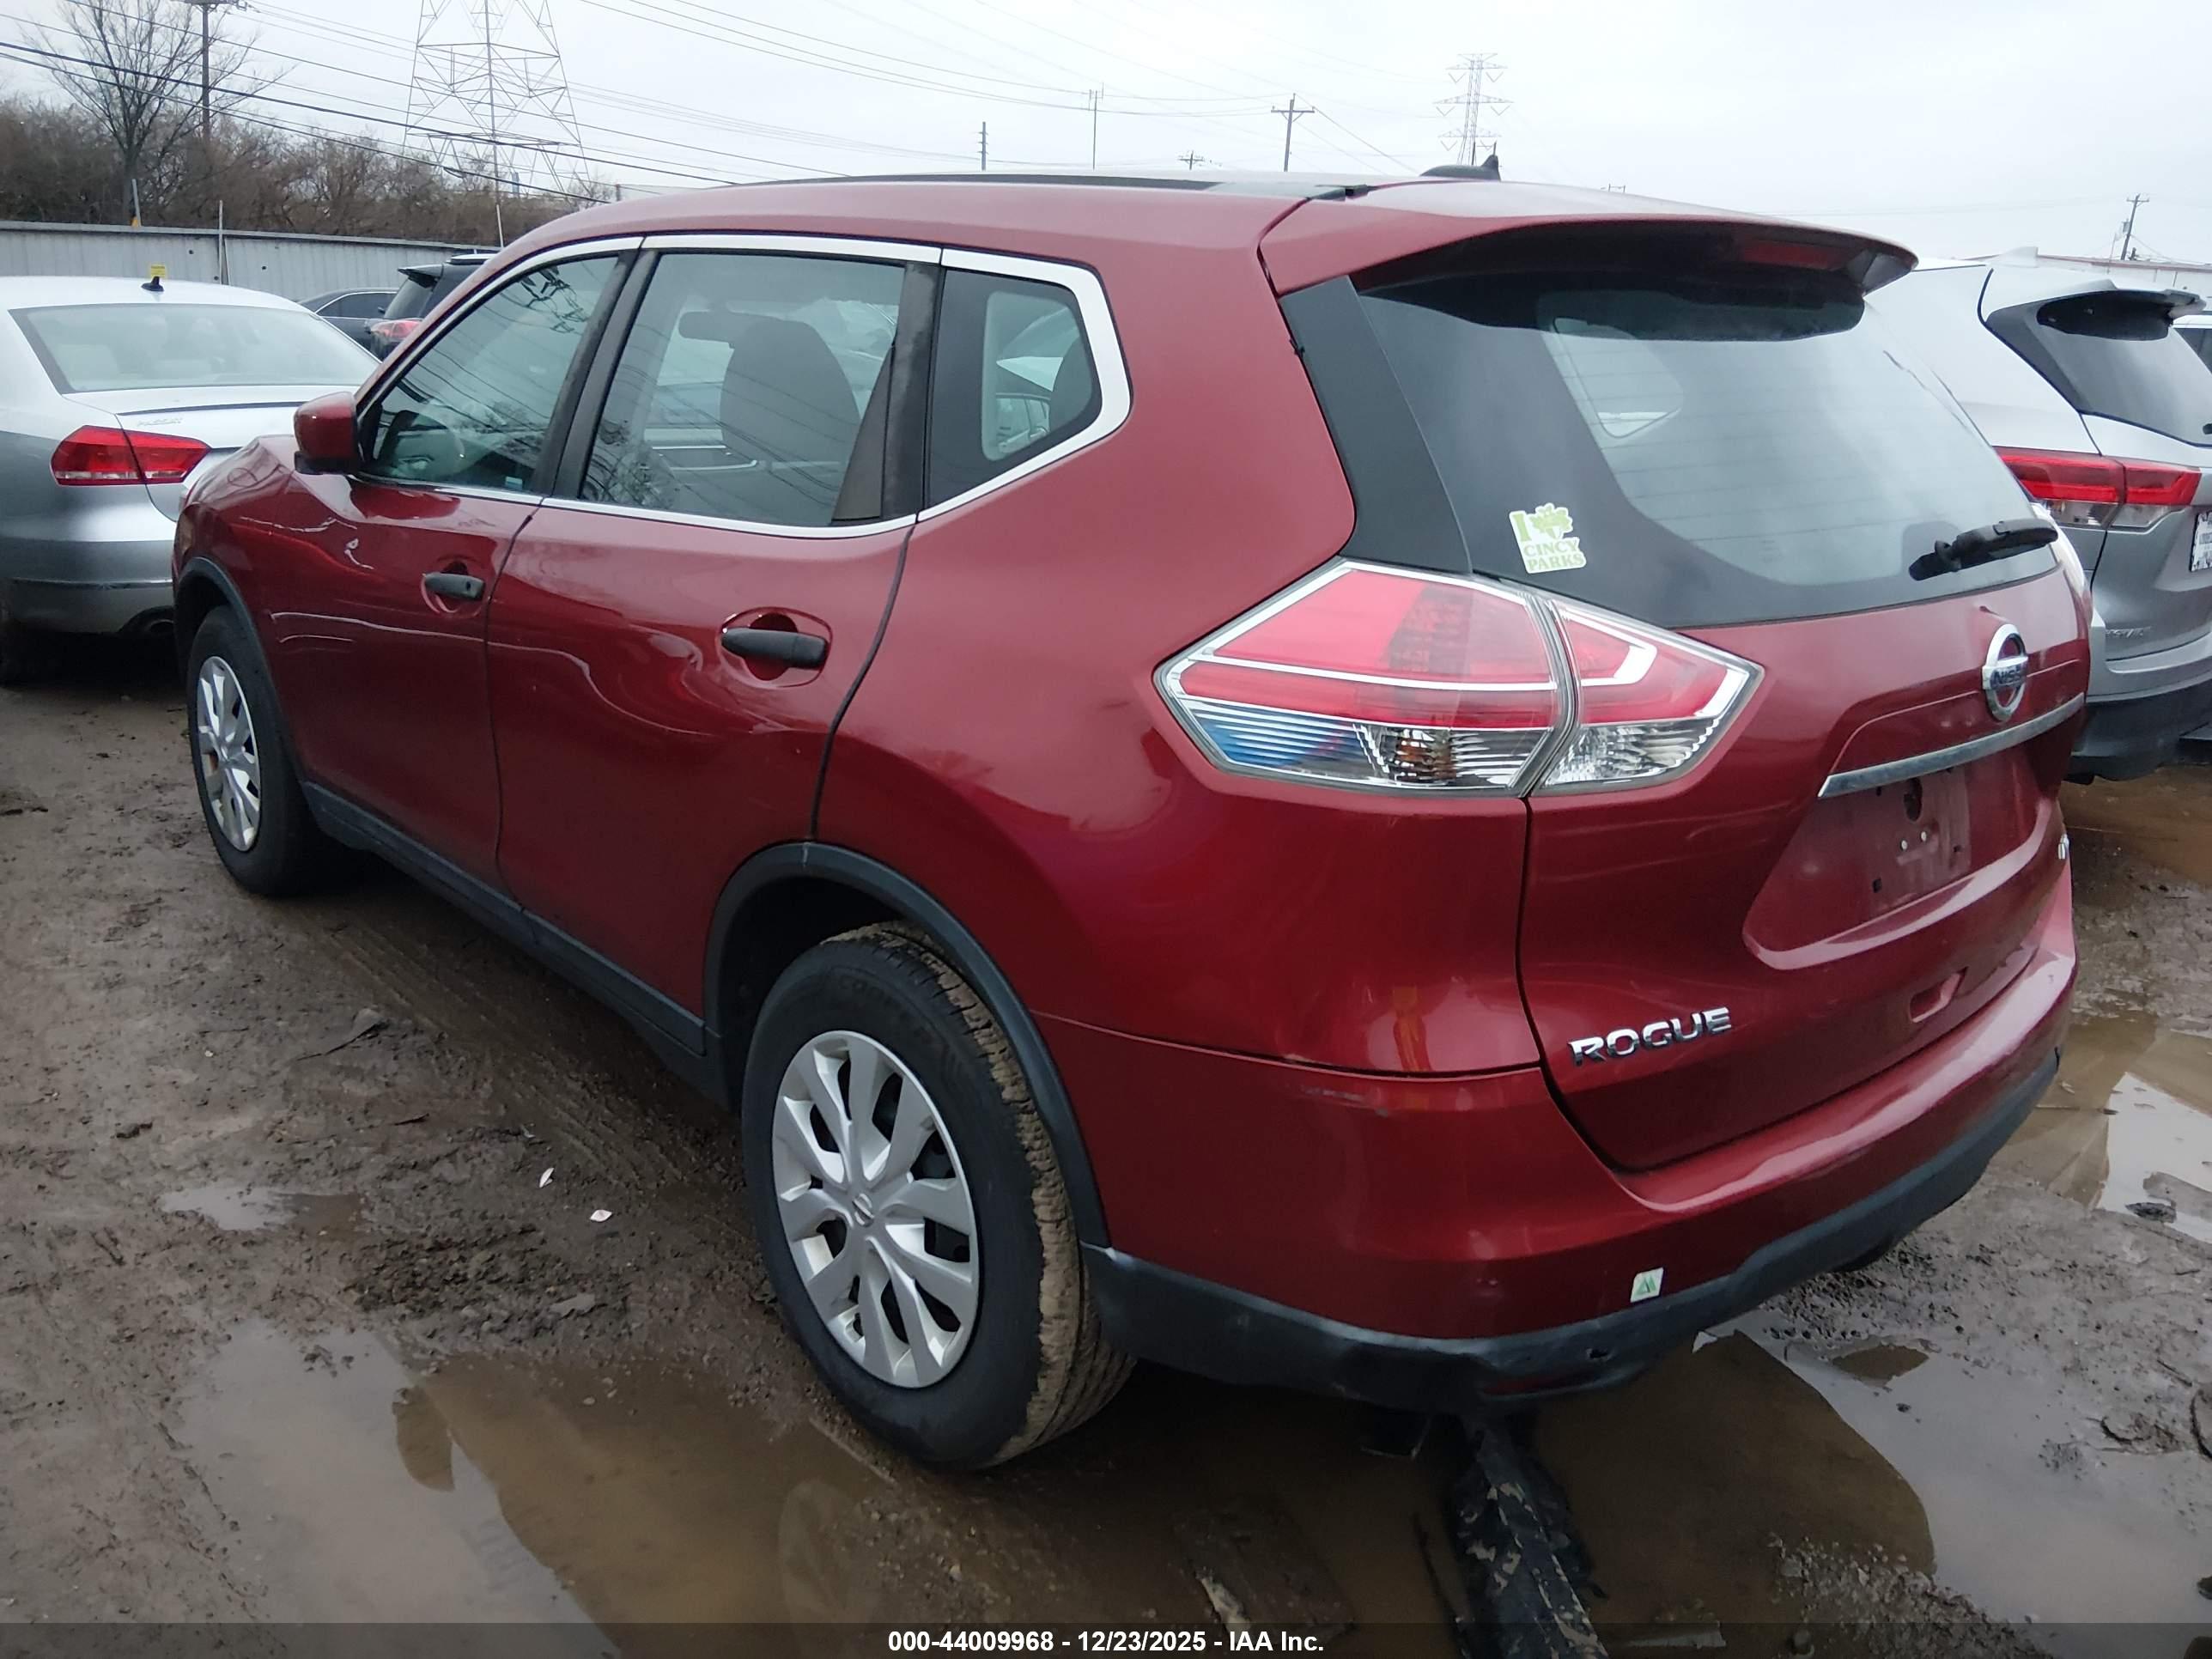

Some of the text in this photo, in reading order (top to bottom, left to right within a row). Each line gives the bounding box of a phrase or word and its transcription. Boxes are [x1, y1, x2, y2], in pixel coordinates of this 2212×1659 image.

[1511, 513, 1532, 543] I
[1523, 539, 1578, 557] CINCY
[1527, 552, 1585, 571] PARKS
[1567, 1006, 1732, 1066] ROGUE
